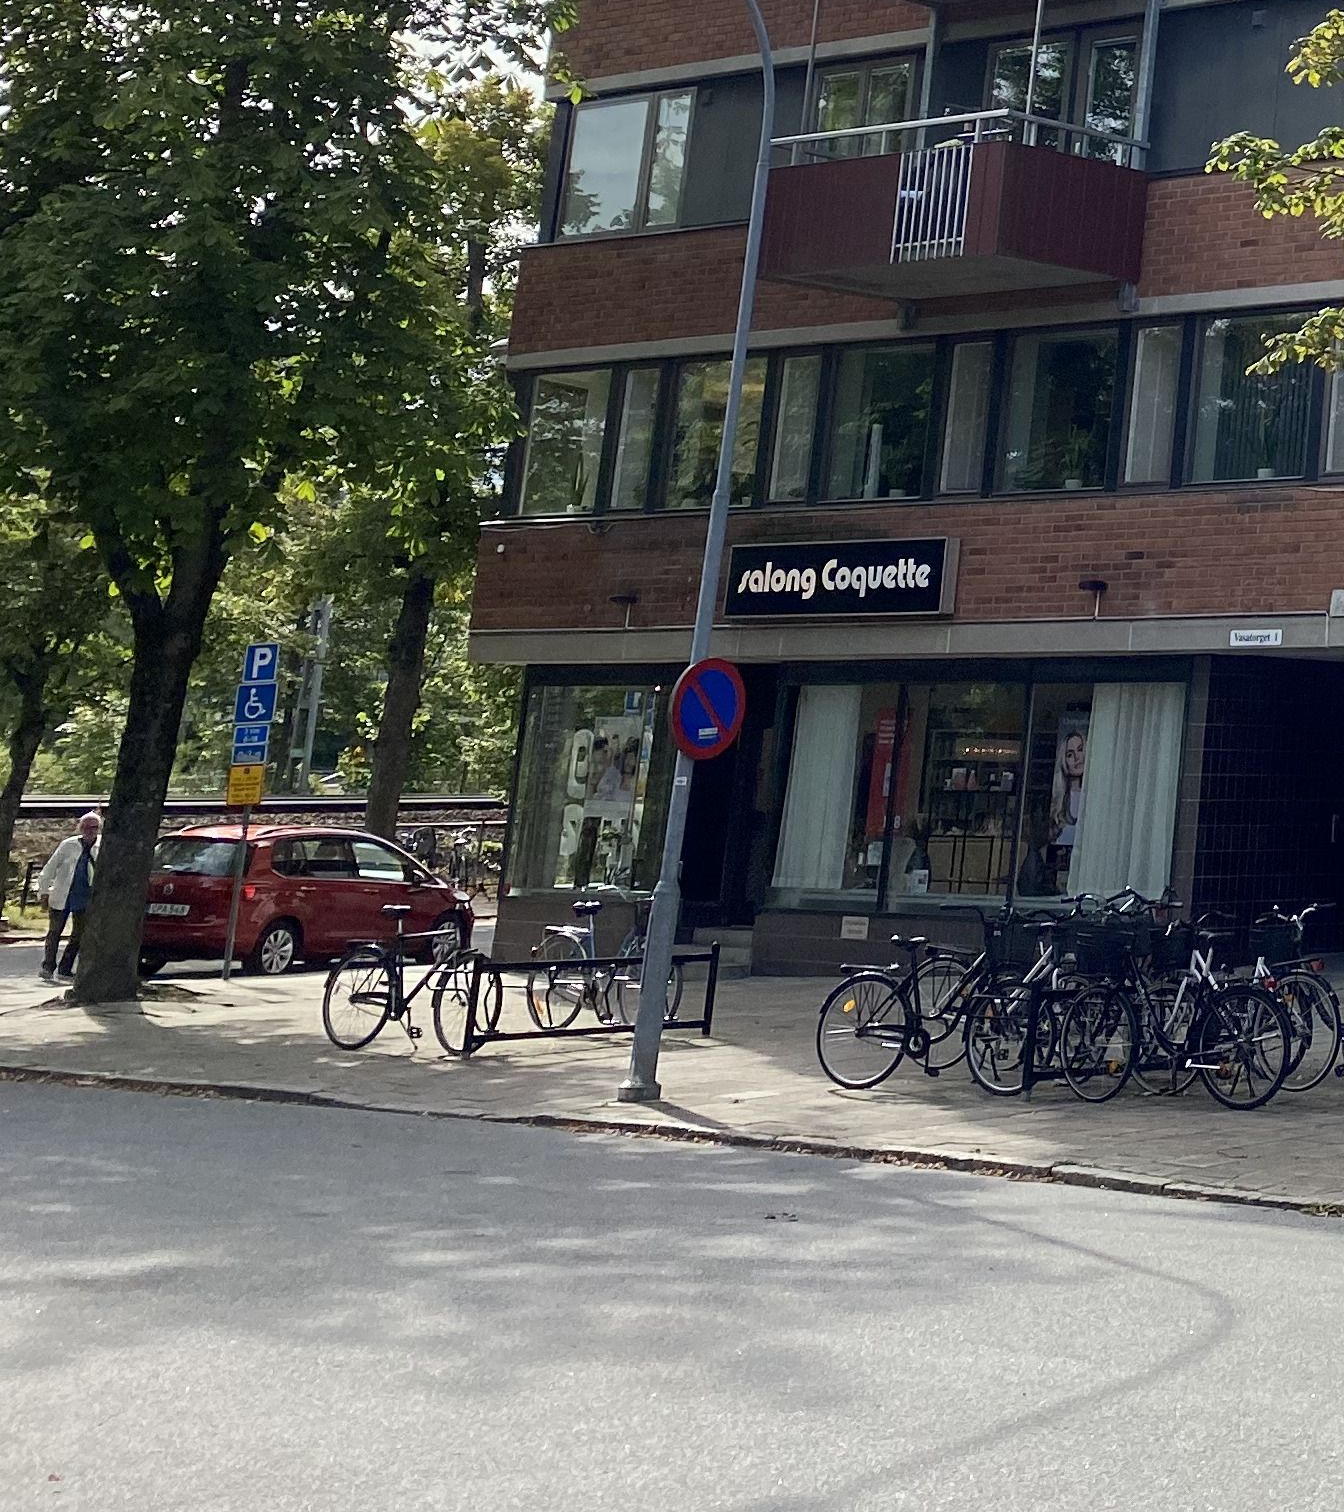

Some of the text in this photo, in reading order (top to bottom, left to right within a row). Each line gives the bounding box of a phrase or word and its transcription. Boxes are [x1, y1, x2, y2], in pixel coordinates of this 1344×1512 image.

[737, 558, 931, 600] salong Coquette
[251, 647, 273, 679] P
